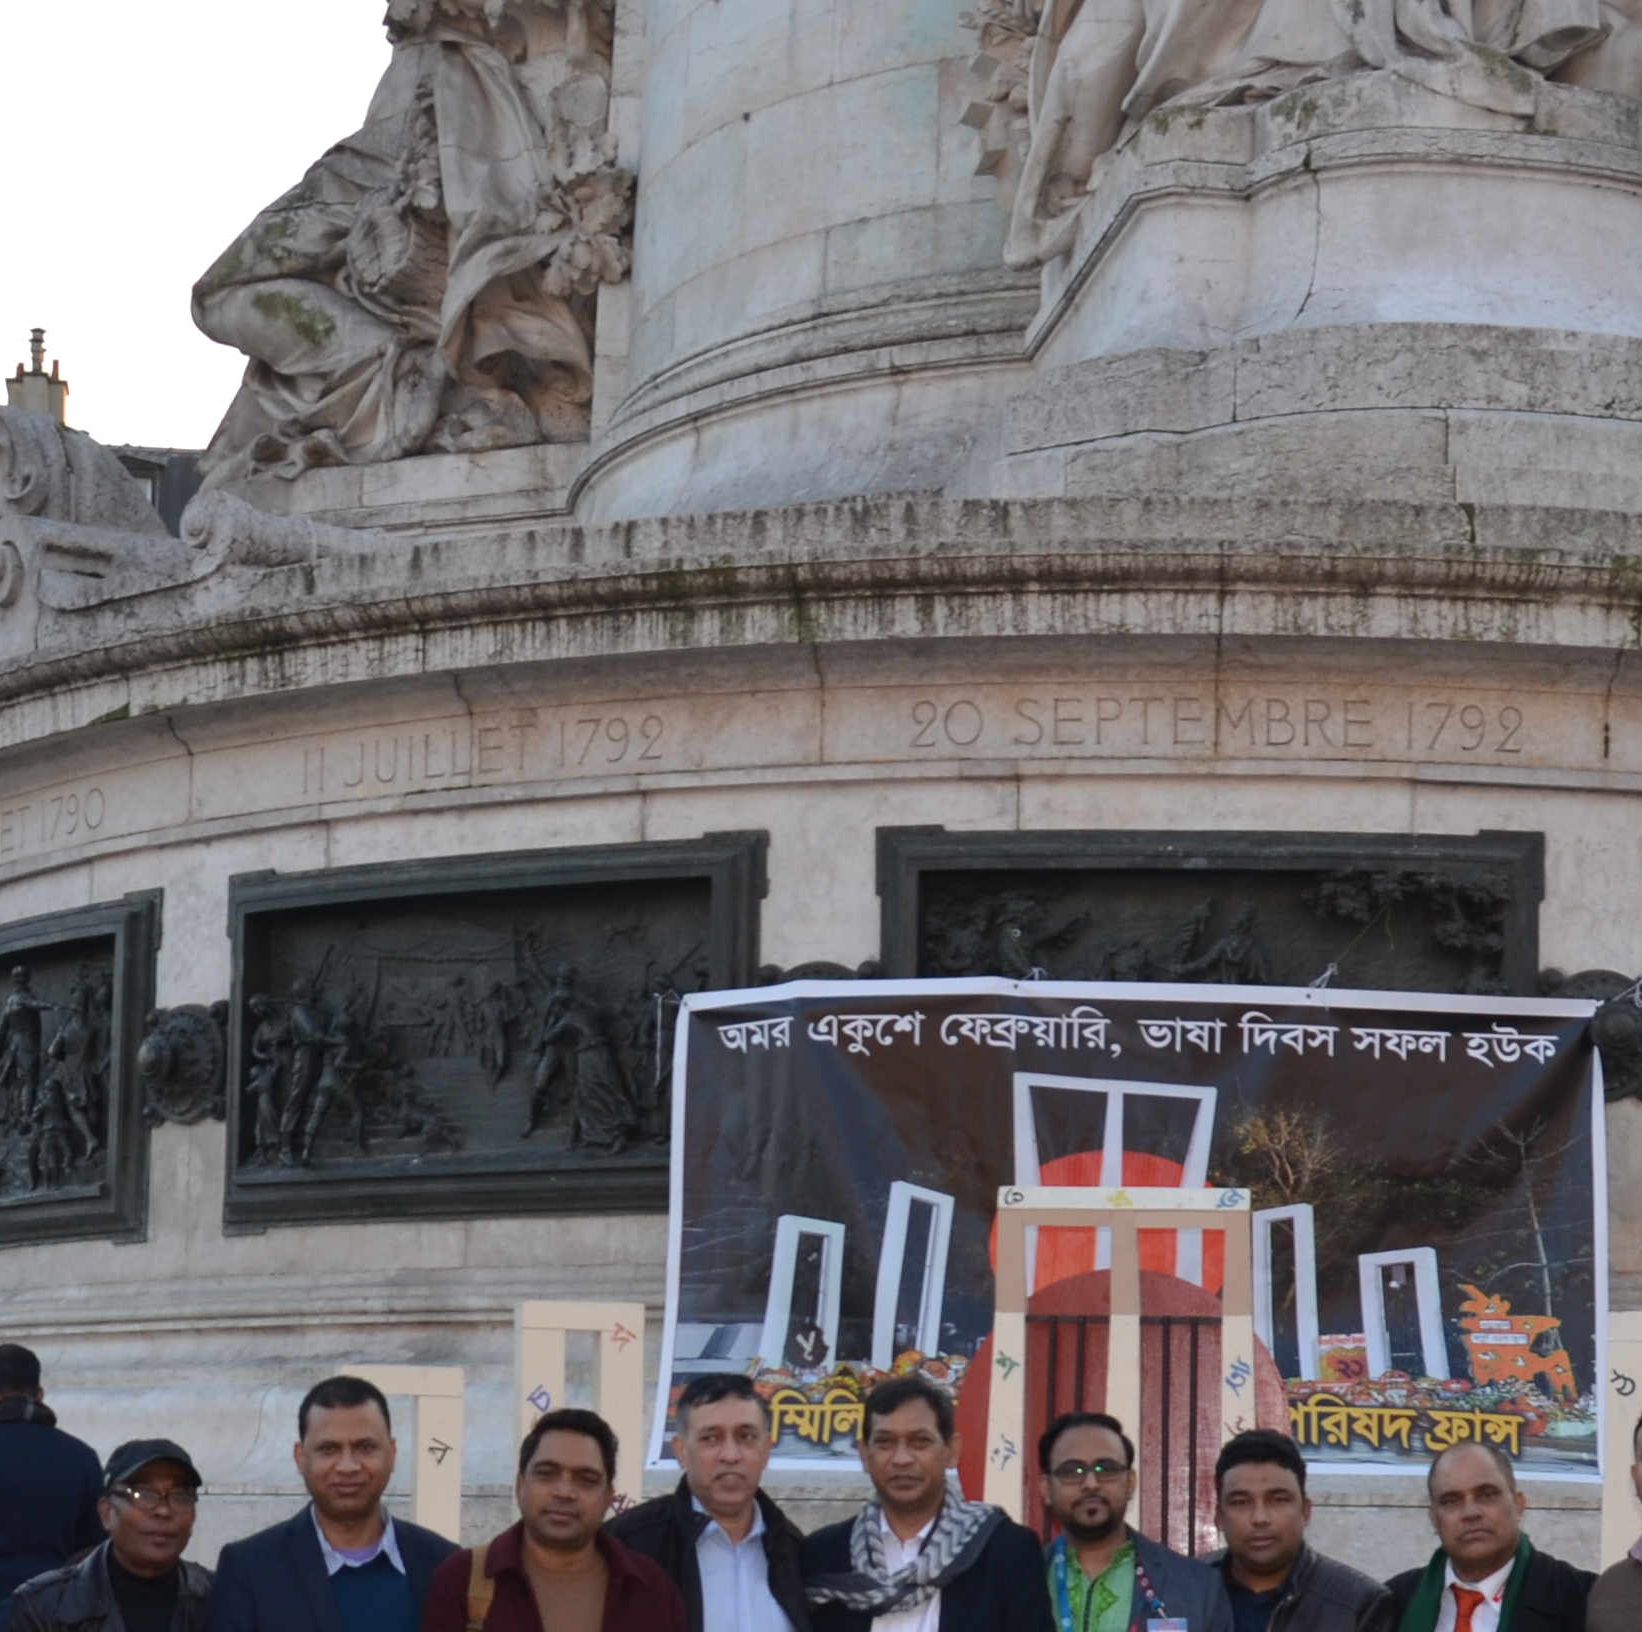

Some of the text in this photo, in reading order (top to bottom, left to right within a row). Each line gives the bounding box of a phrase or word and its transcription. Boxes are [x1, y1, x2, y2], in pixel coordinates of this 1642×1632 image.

[344, 723, 537, 788] JUILLET
[559, 715, 664, 767] 1792
[909, 697, 1523, 754] 20 SEPTEMBRE 1792
[40, 787, 106, 844] 1790
[717, 1016, 795, 1054] অমর
[807, 1011, 926, 1056] একুশে
[1137, 1017, 1227, 1054] ভাষা
[1237, 1011, 1340, 1058] দিবস
[1350, 1026, 1452, 1063] সফল
[1462, 1021, 1559, 1068] হউক
